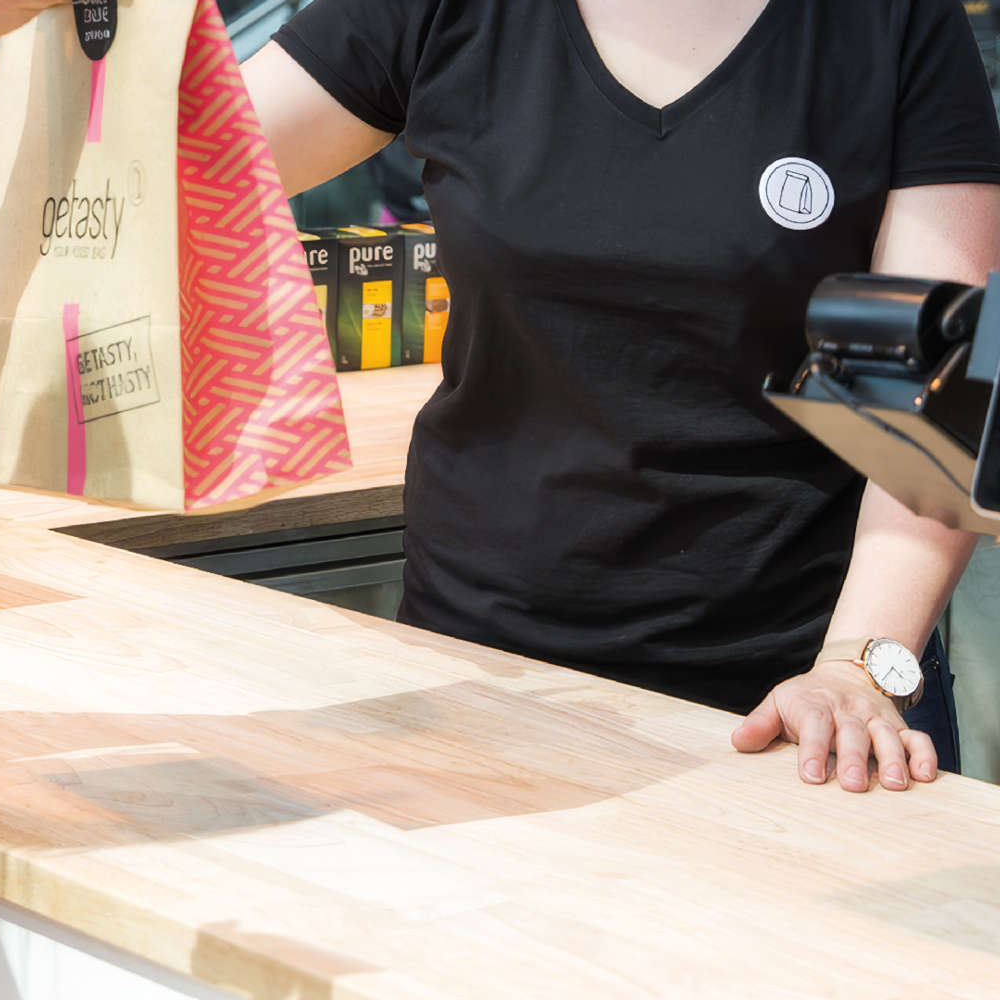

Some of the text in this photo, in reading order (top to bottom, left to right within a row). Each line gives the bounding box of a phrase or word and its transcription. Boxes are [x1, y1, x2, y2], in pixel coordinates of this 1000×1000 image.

[40, 178, 125, 260] getasty
[349, 245, 393, 274] pure
[413, 243, 437, 271] pu
